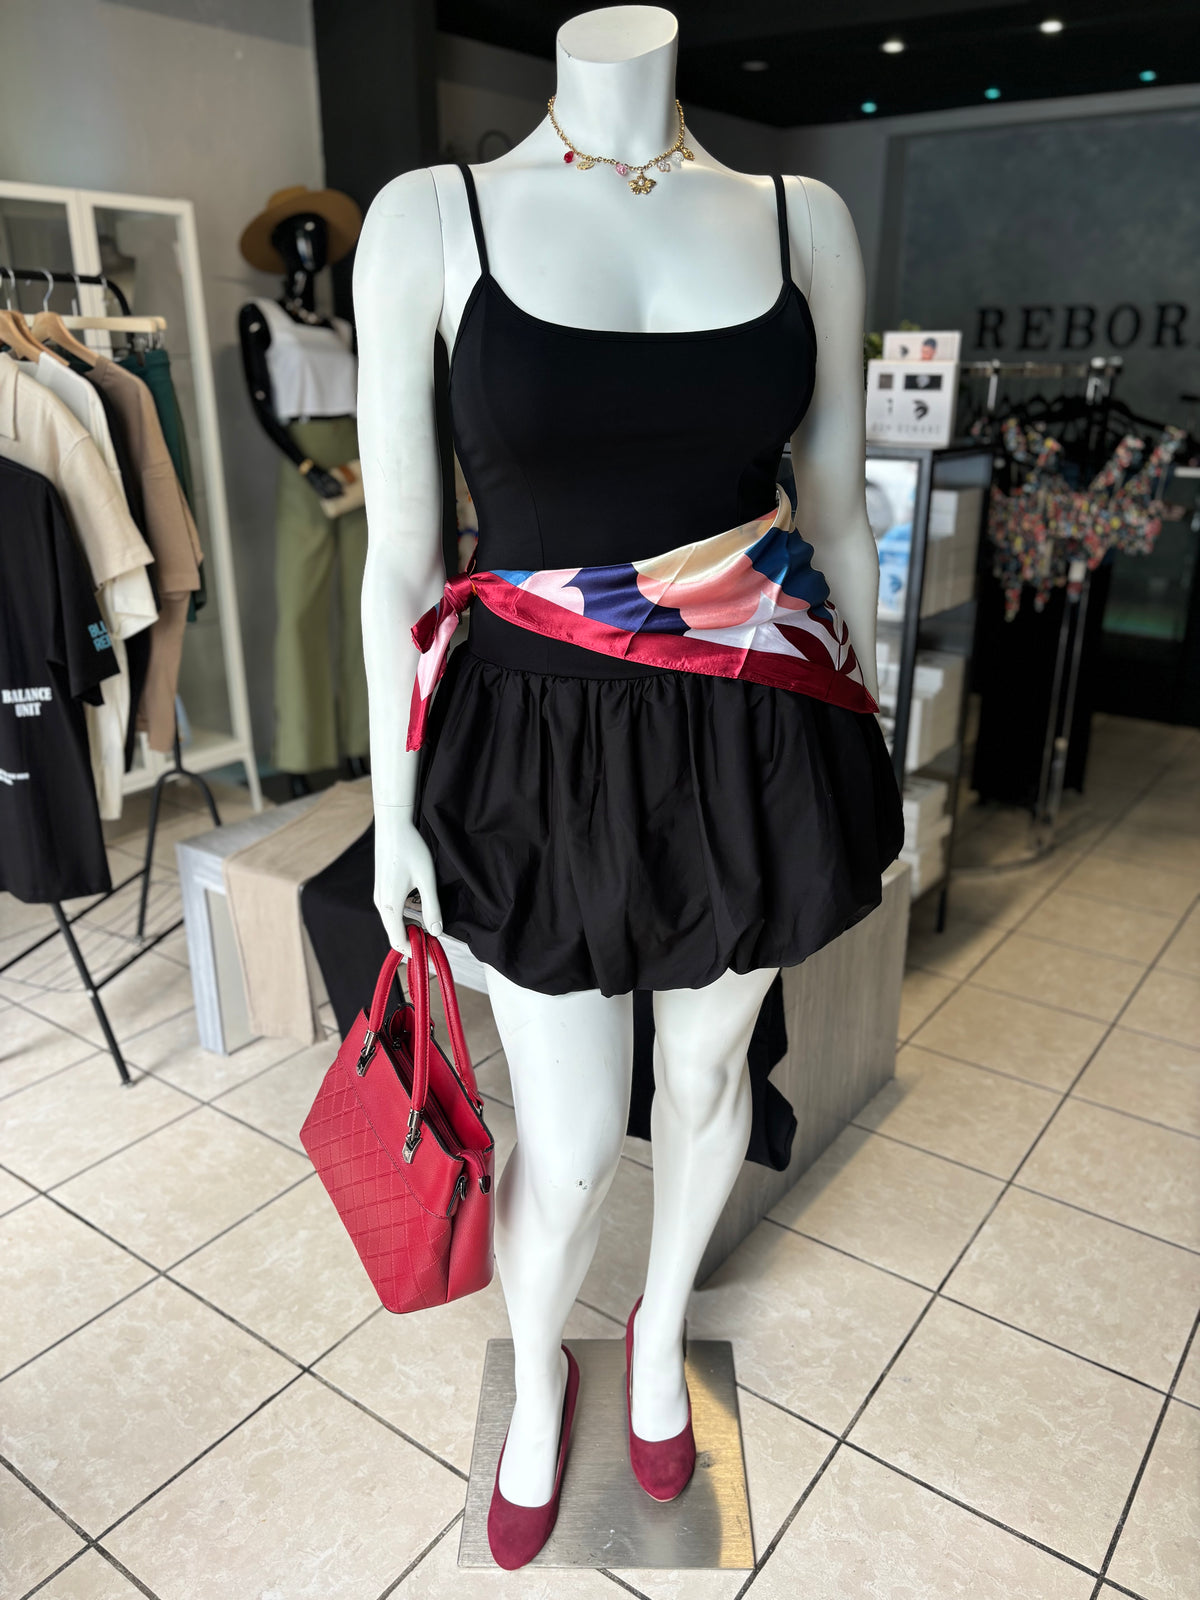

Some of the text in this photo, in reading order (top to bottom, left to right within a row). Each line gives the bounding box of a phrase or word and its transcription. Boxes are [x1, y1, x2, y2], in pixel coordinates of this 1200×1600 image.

[974, 302, 1200, 352] REBOR
[2, 686, 52, 704] BALANCE
[15, 701, 42, 718] UNIT
